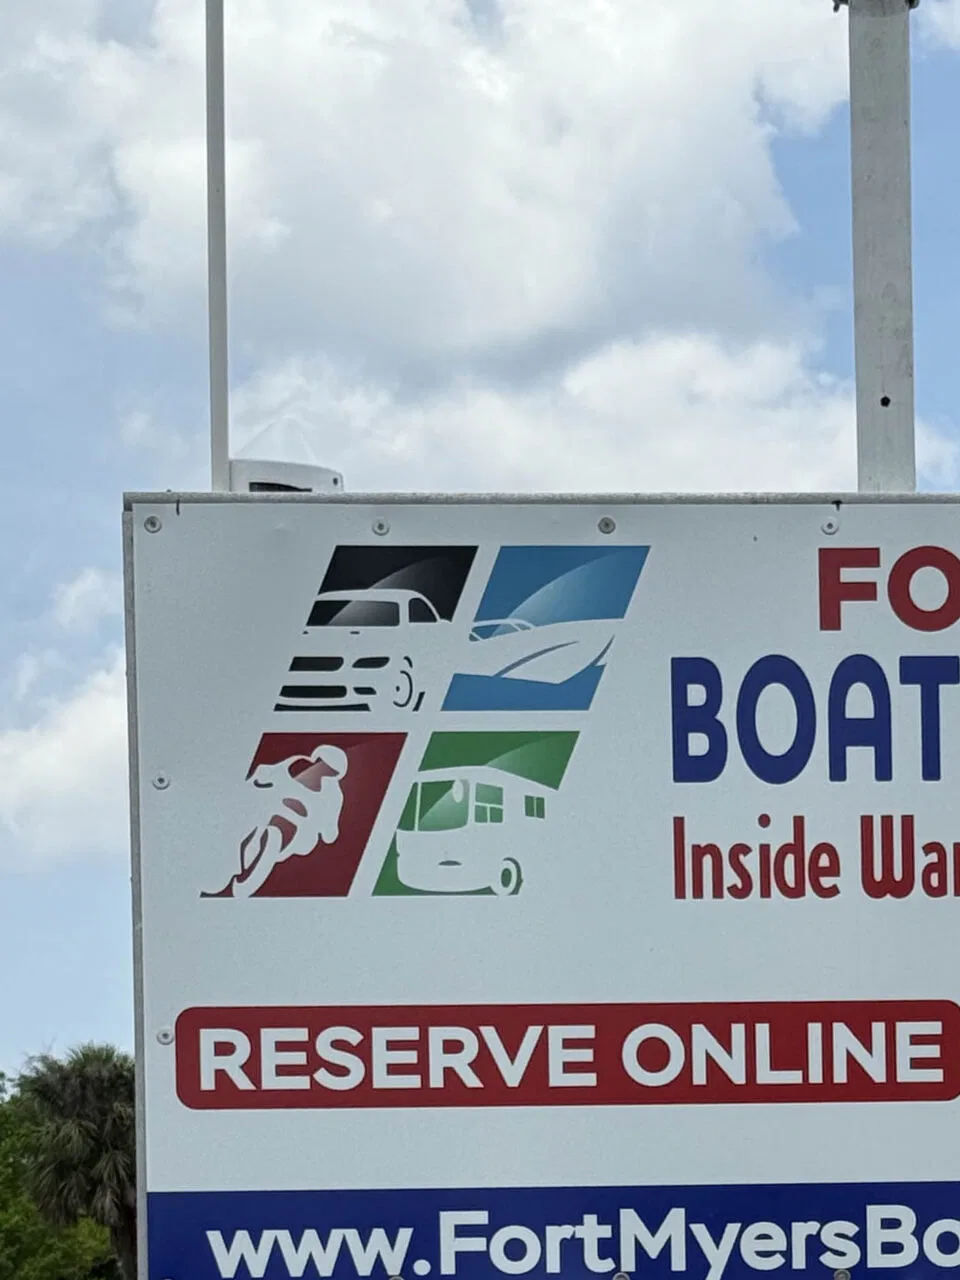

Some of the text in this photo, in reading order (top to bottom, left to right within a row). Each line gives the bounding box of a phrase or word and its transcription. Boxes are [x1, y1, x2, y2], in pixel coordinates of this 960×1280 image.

[671, 653, 960, 784] BOAT
[674, 813, 841, 900] Inside
[199, 1020, 944, 1092] RESERVE ONLINE
